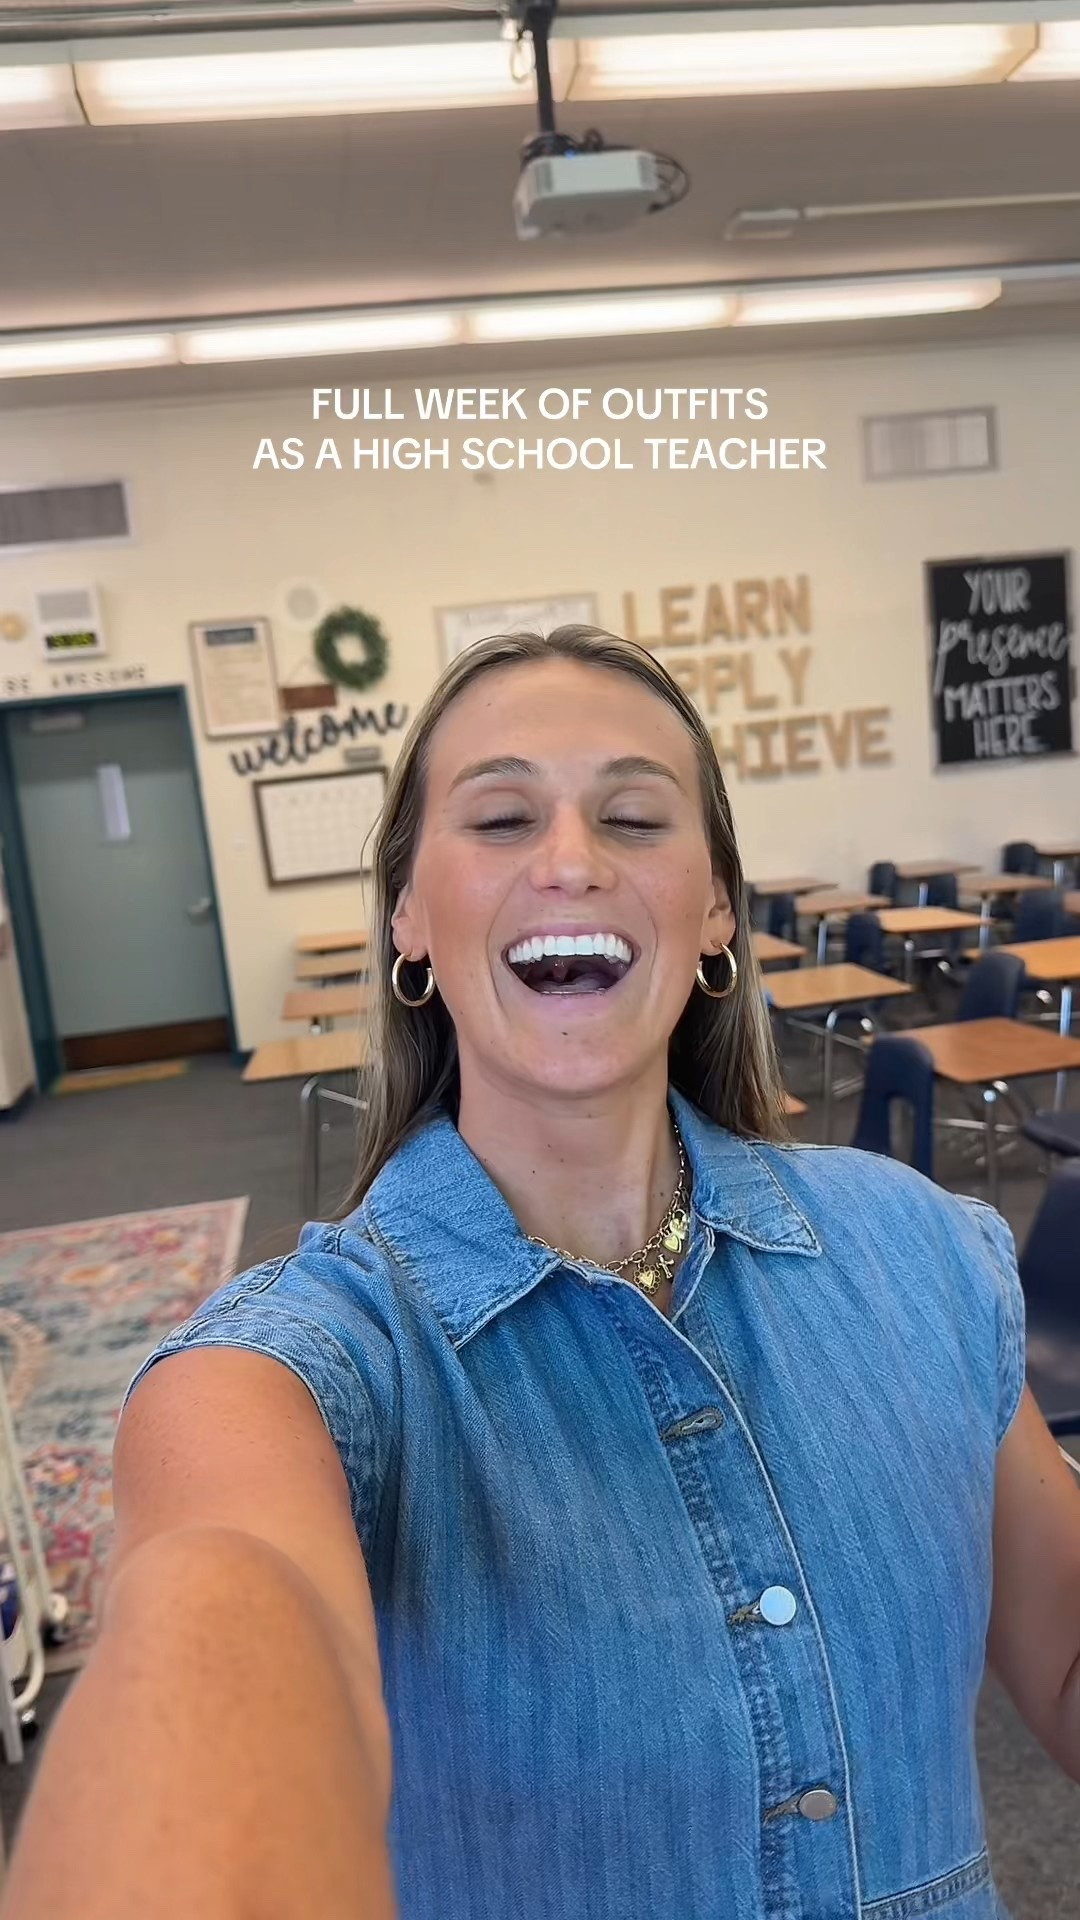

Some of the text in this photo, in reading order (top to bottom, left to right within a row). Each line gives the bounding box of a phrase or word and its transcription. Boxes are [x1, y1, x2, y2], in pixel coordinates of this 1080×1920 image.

[621, 575, 812, 650] LEARN
[963, 567, 1031, 615] YOUR
[663, 646, 813, 714] PPLY
[944, 670, 1061, 722] MATTERS
[229, 701, 408, 776] welcome
[711, 705, 893, 782] HIEVE
[973, 711, 1050, 757] HERE
